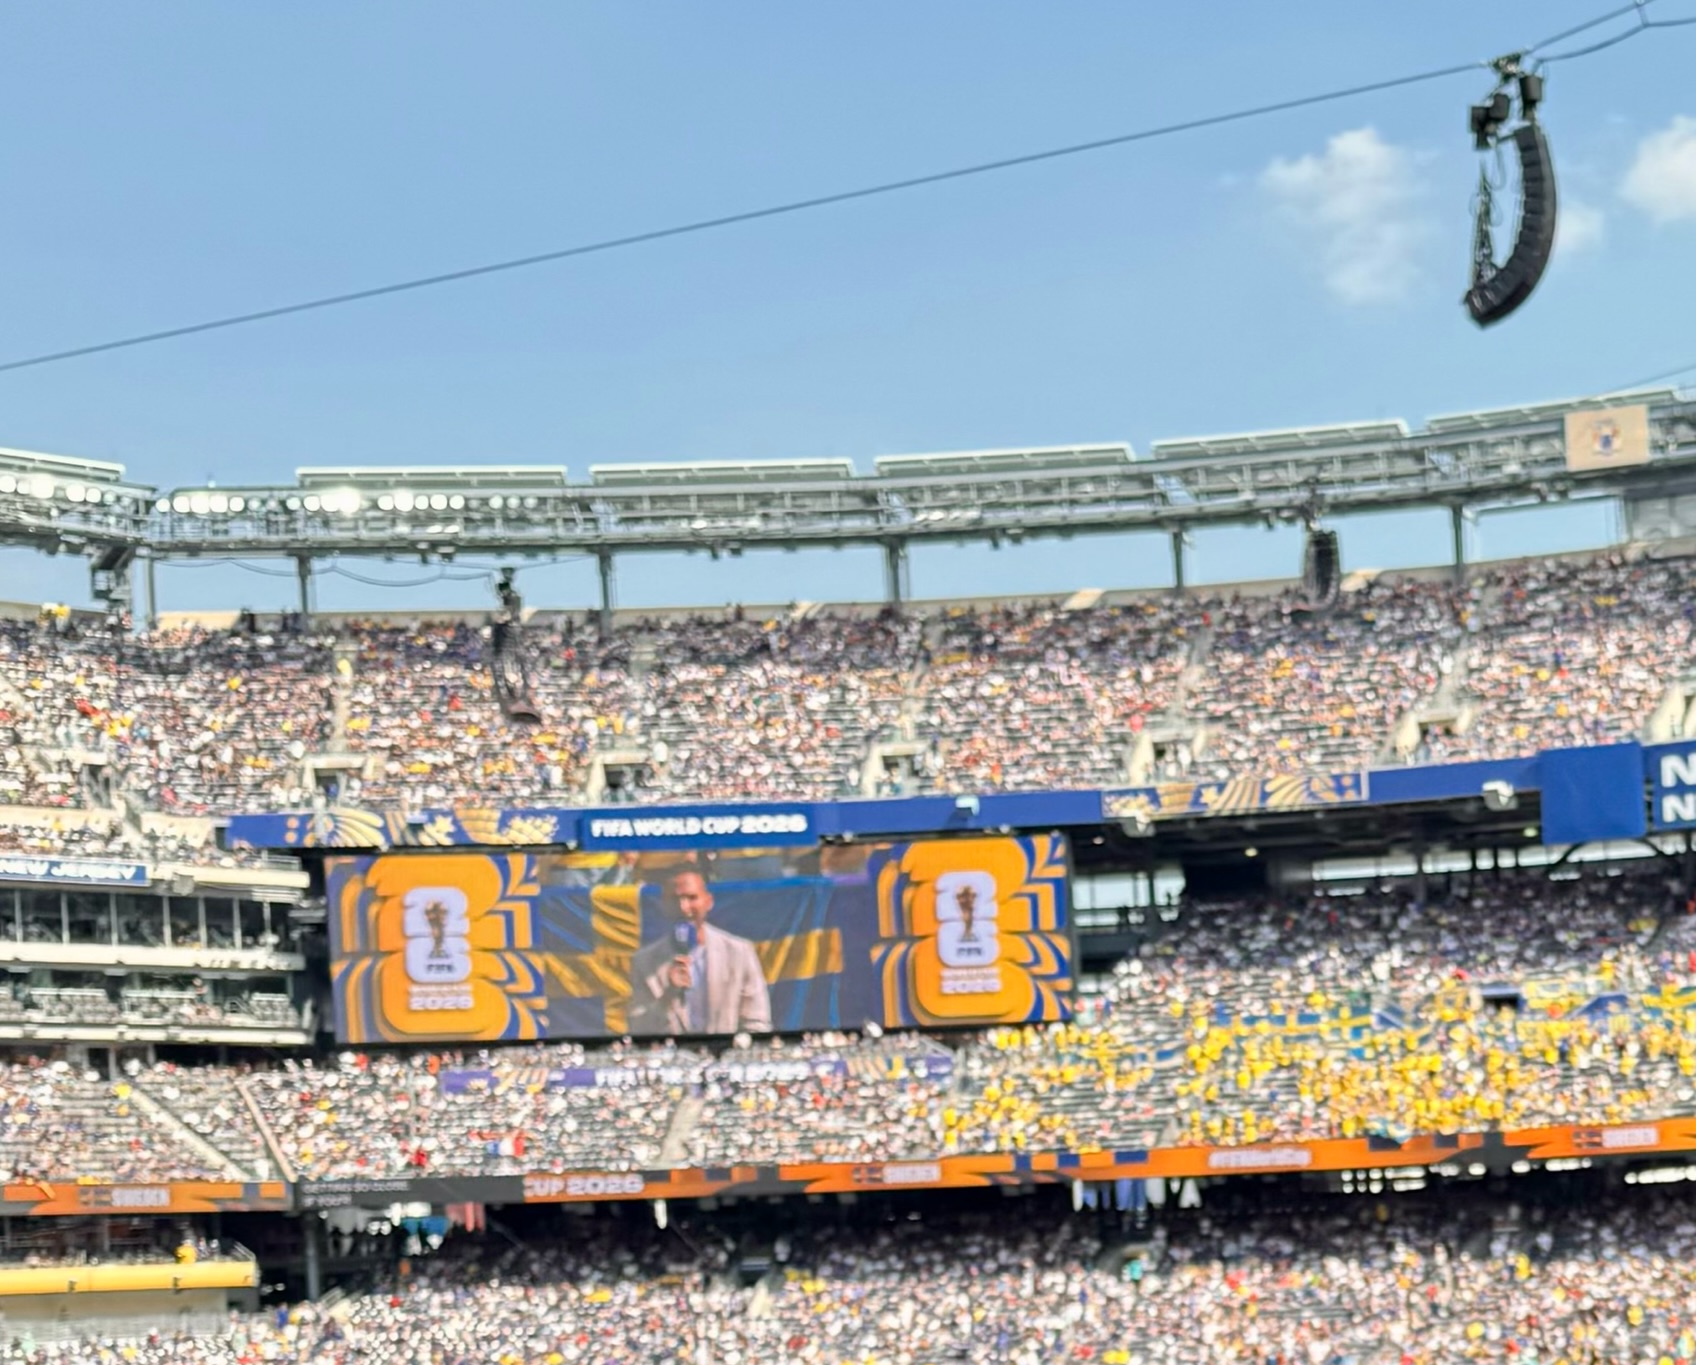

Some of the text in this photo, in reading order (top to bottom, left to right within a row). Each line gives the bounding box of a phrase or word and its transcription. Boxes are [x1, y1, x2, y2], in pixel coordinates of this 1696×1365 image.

[633, 817, 700, 836] WORLD
[702, 816, 740, 834] CUP
[566, 1173, 645, 1196] 2026
